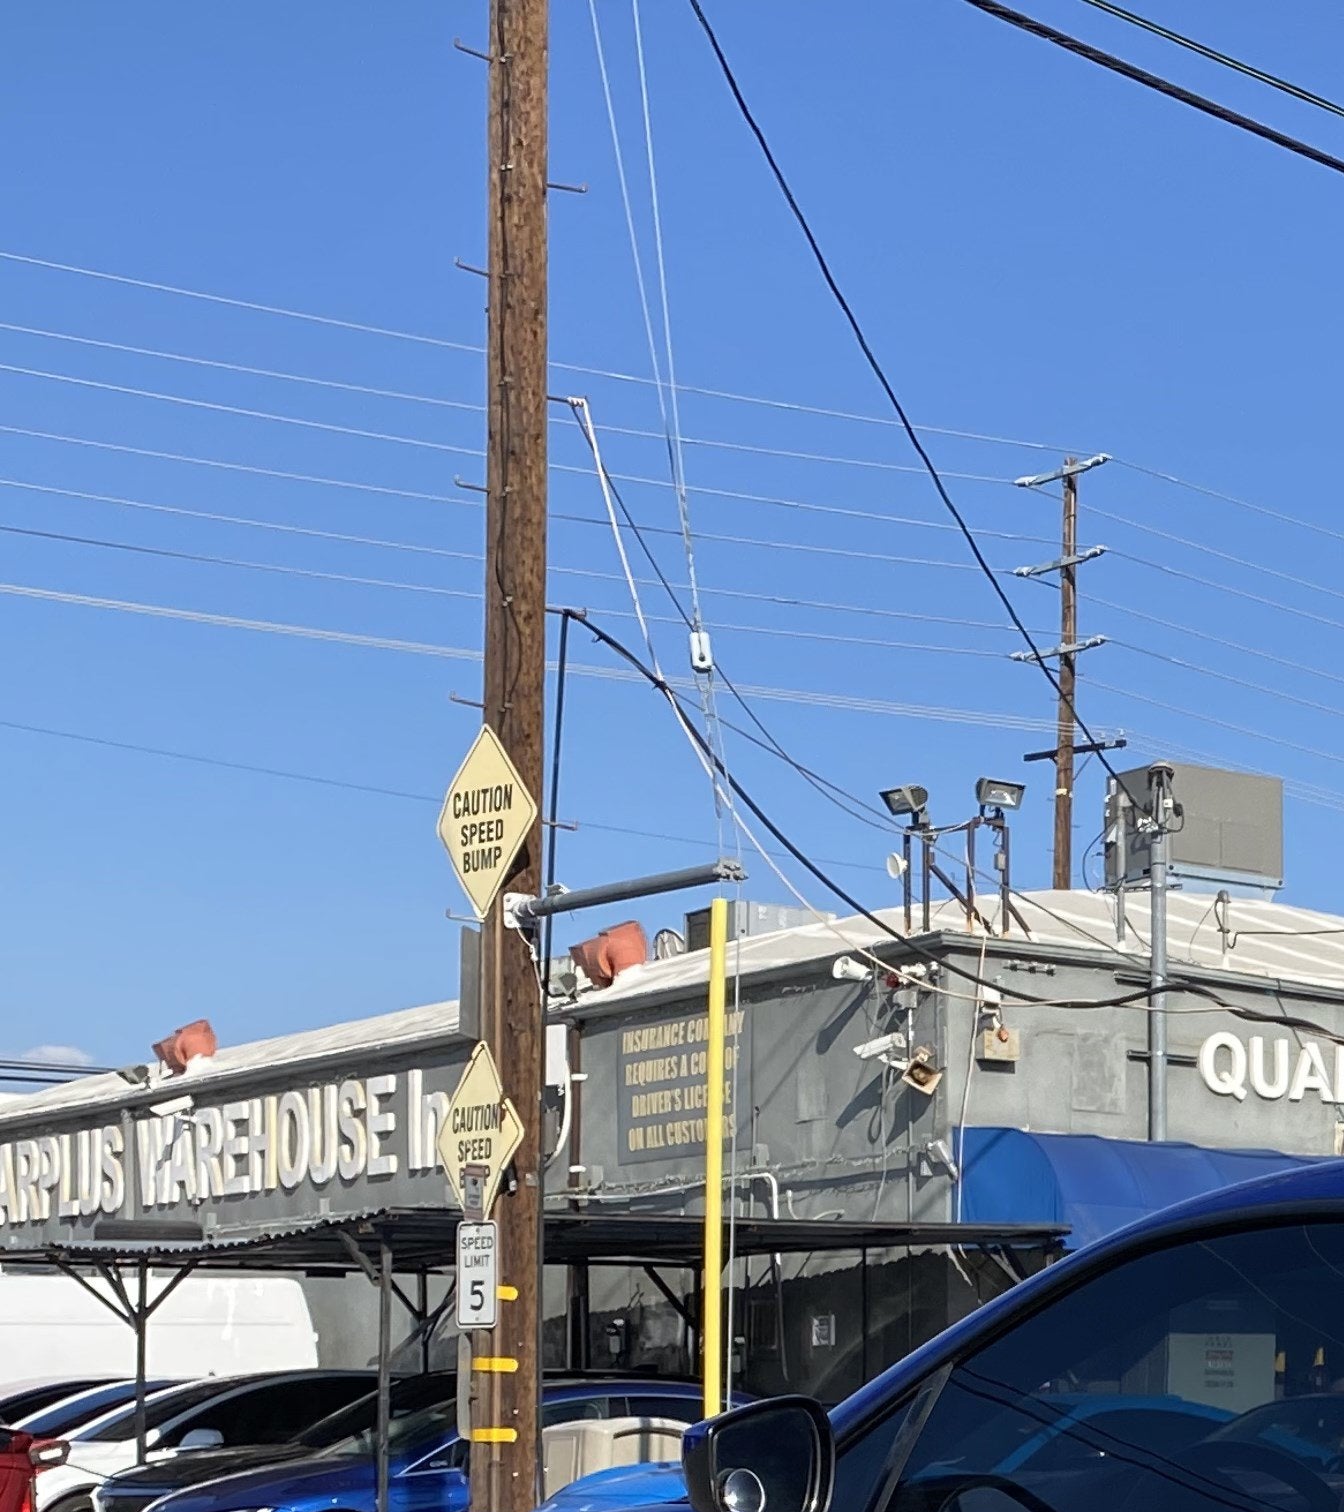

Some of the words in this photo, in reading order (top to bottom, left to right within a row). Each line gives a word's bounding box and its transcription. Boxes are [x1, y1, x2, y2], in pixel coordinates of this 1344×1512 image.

[452, 783, 513, 820] CAUTION
[460, 818, 504, 847] SPEED
[463, 846, 503, 873] BUMP
[622, 1021, 686, 1055] INSURANCE
[625, 1055, 678, 1087] REQUIRES
[679, 1053, 688, 1077] A
[632, 1088, 682, 1118] DRIVER'S
[684, 1080, 731, 1110] LICEE
[452, 1103, 499, 1134] CAUTION
[136, 1074, 398, 1207] WAREHOUSE
[458, 1137, 492, 1162] SPEED
[628, 1127, 644, 1152] ON
[646, 1124, 665, 1149] ALL
[461, 1236, 494, 1249] SPEED
[464, 1254, 491, 1268] LIMIT
[469, 1280, 485, 1311] 5
